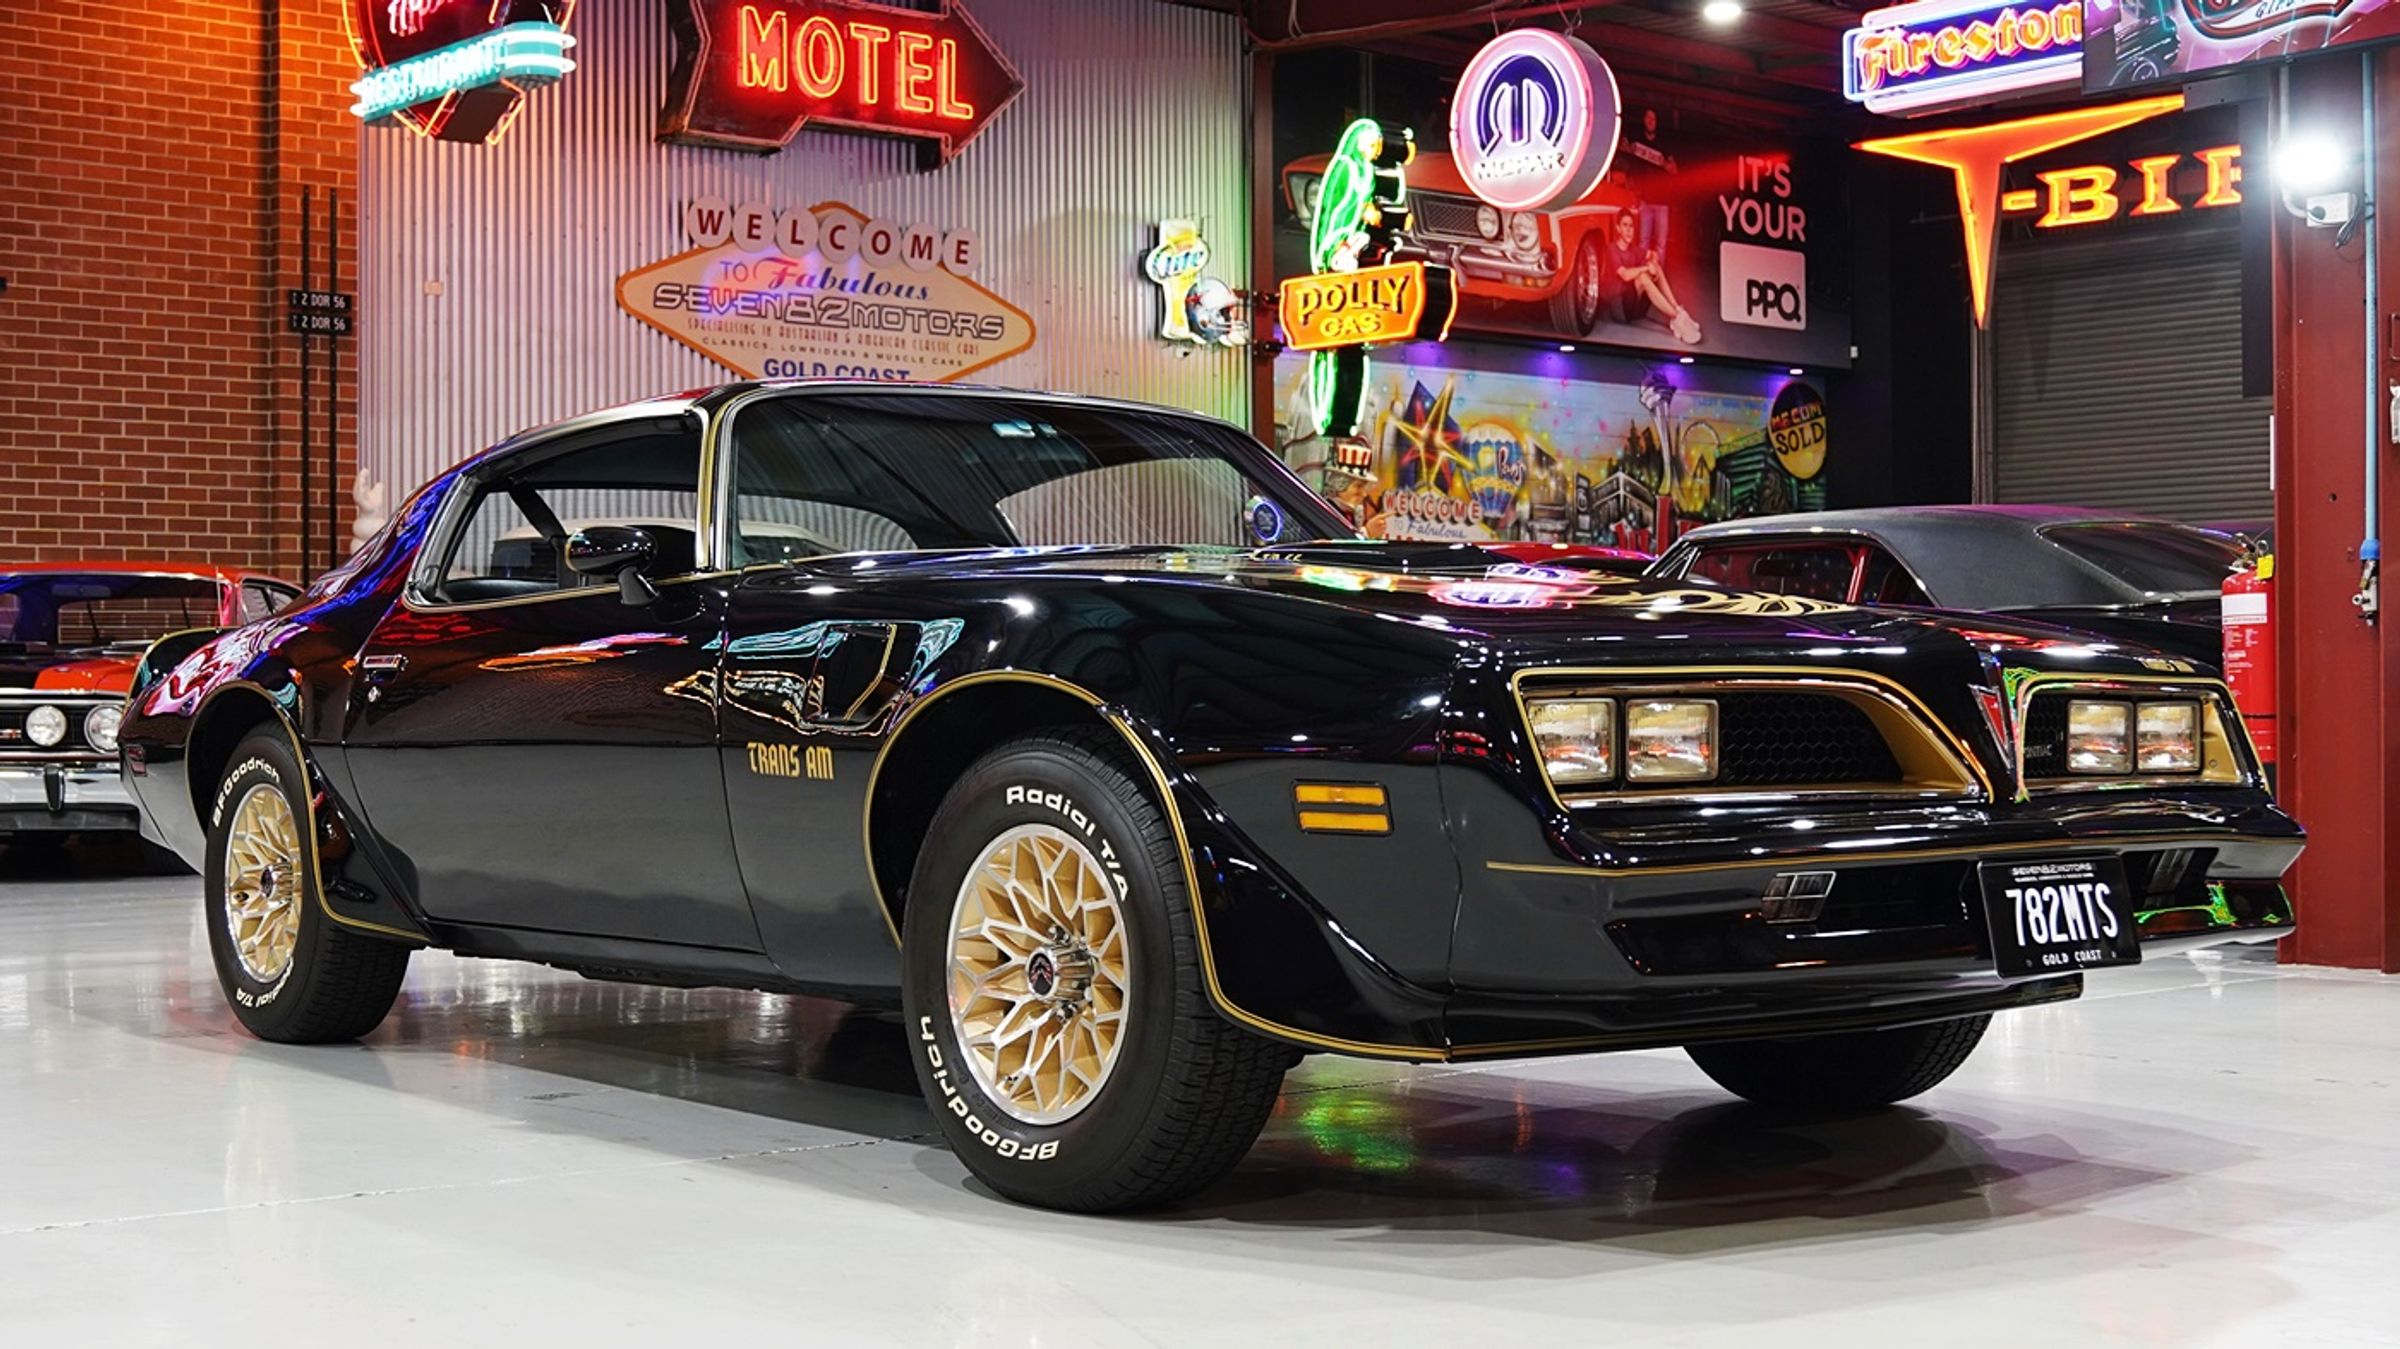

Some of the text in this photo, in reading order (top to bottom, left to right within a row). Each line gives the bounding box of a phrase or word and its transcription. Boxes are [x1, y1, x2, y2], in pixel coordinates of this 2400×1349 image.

[740, 5, 974, 119] MOTEL
[1738, 155, 1791, 198] IT'S
[697, 209, 969, 265] WELCOME
[1718, 194, 1806, 242] YOUR
[720, 257, 929, 300] TO Fabulous
[1295, 274, 1410, 326] POLLY
[1747, 278, 1802, 322] PPQ
[653, 283, 1004, 341] SEVEN82MOTORS
[1320, 312, 1381, 337] GAS
[781, 344, 856, 358] LOWRIDERS
[877, 352, 925, 364] MUSCLE
[932, 357, 963, 367] CARS
[858, 333, 906, 349] AMERICAN
[764, 358, 826, 377] GOLD
[1775, 422, 1825, 455] SOLD
[1385, 494, 1481, 520] WELCOME
[1407, 519, 1467, 538] Fabulous
[747, 742, 835, 779] TRANS AM
[213, 756, 280, 828] BFGoodrich
[1006, 785, 1129, 902] Radial T/A
[2004, 882, 2119, 947] 782MTS
[2042, 949, 2103, 966] GOLD COAST
[920, 1016, 1061, 1161] BFGoodrich
